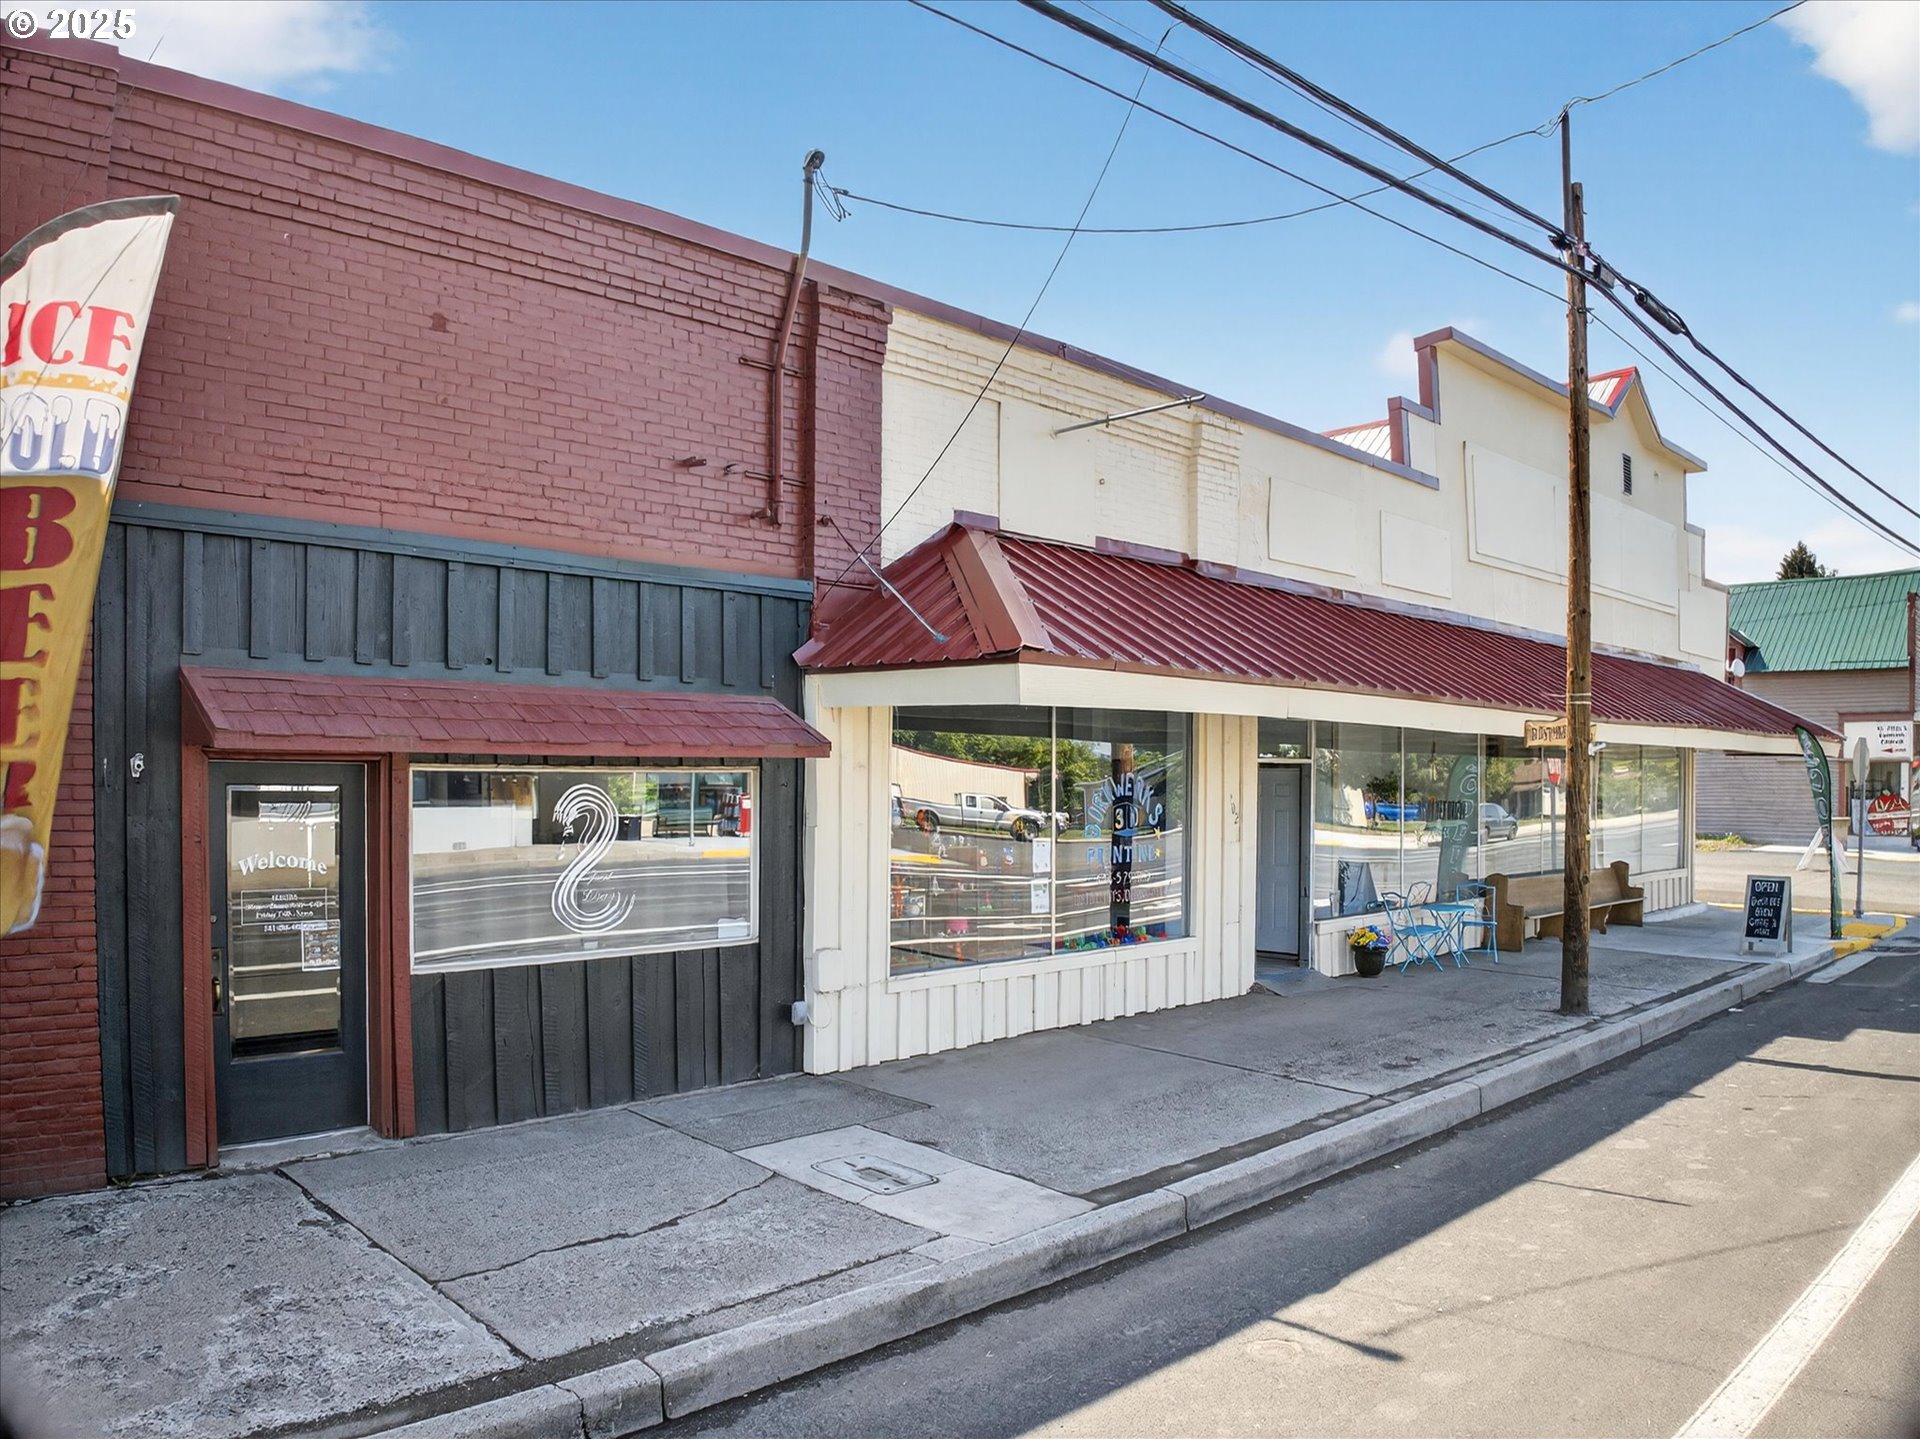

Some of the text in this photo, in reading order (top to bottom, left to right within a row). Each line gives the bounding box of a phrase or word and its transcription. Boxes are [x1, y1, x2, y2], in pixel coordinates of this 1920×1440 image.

[1, 300, 136, 377] ICE
[0, 392, 122, 475] OLD
[238, 850, 328, 876] Welcome
